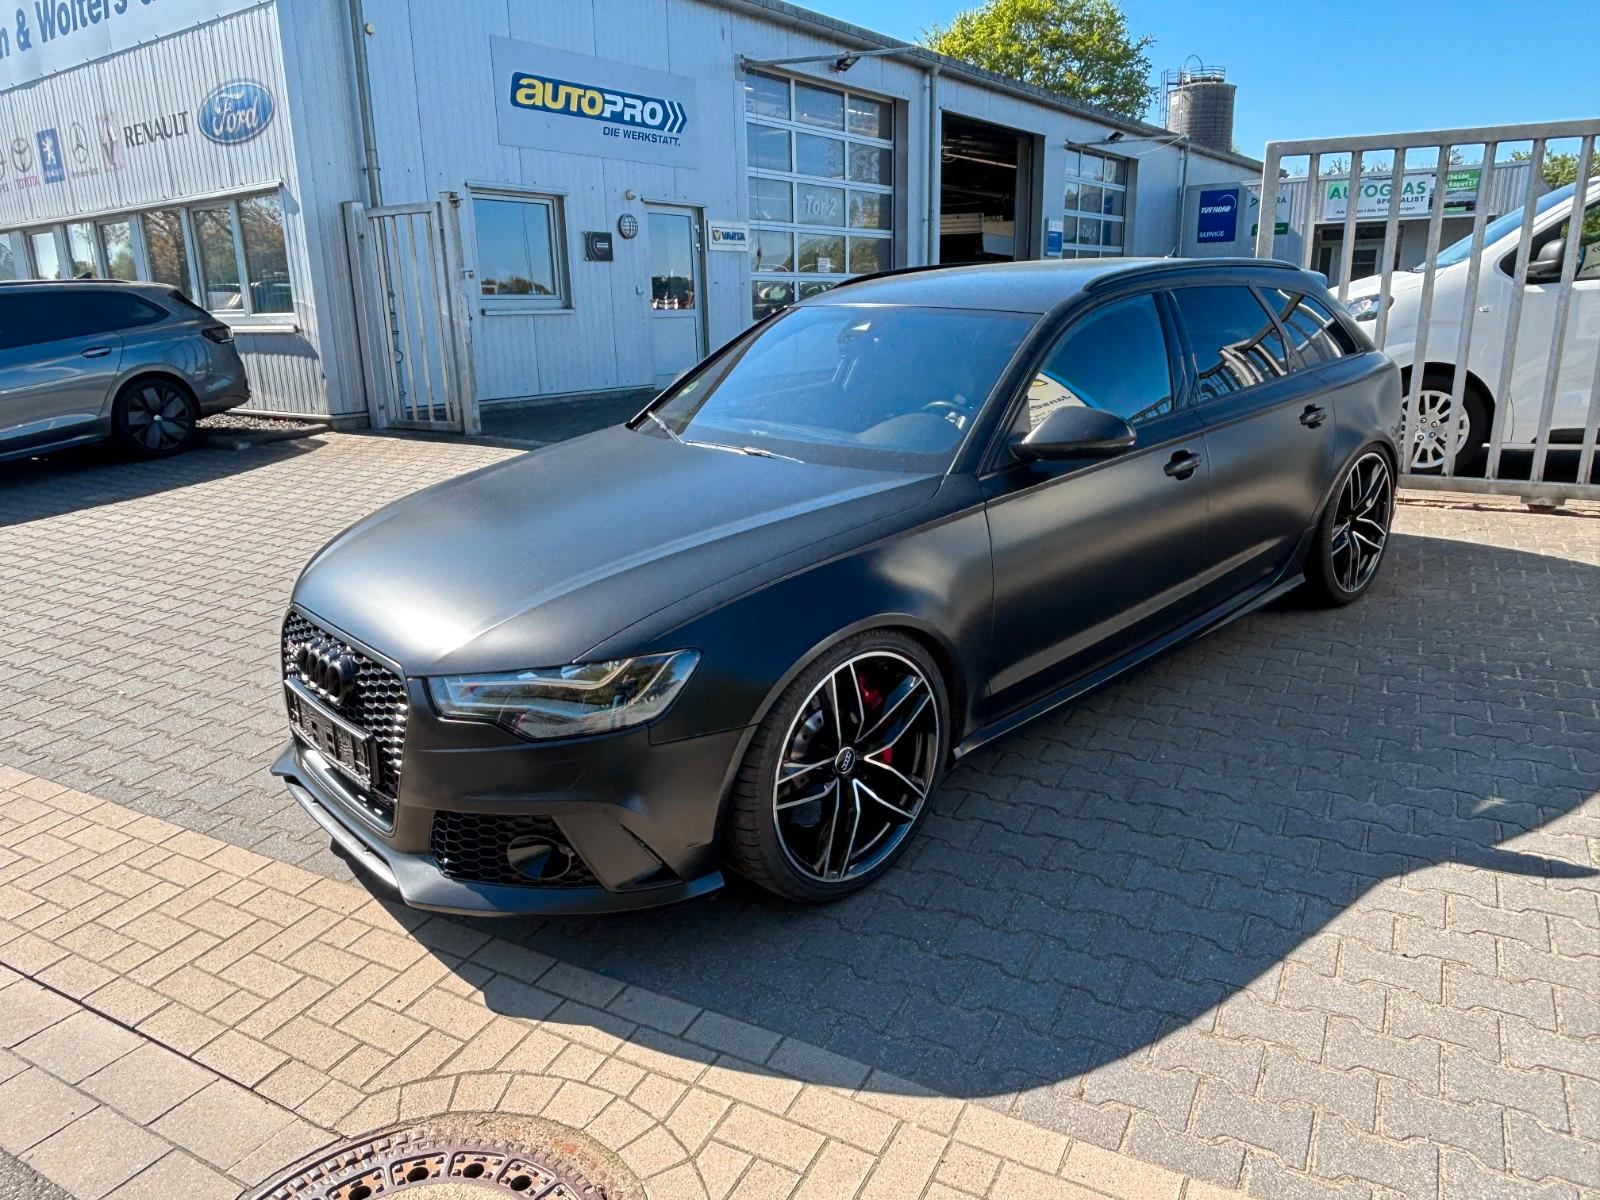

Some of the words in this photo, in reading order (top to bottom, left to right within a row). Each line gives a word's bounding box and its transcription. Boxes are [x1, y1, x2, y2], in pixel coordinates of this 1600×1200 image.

[16, 8, 32, 51] &
[212, 89, 259, 136] Ford
[123, 110, 188, 148] RENAULT
[603, 126, 620, 137] DIE
[623, 129, 681, 147] WERKSTATT.
[1329, 181, 1426, 200] AOGAS
[1376, 196, 1425, 204] SPEALIST
[806, 194, 826, 215] Tor
[828, 198, 837, 216] 2
